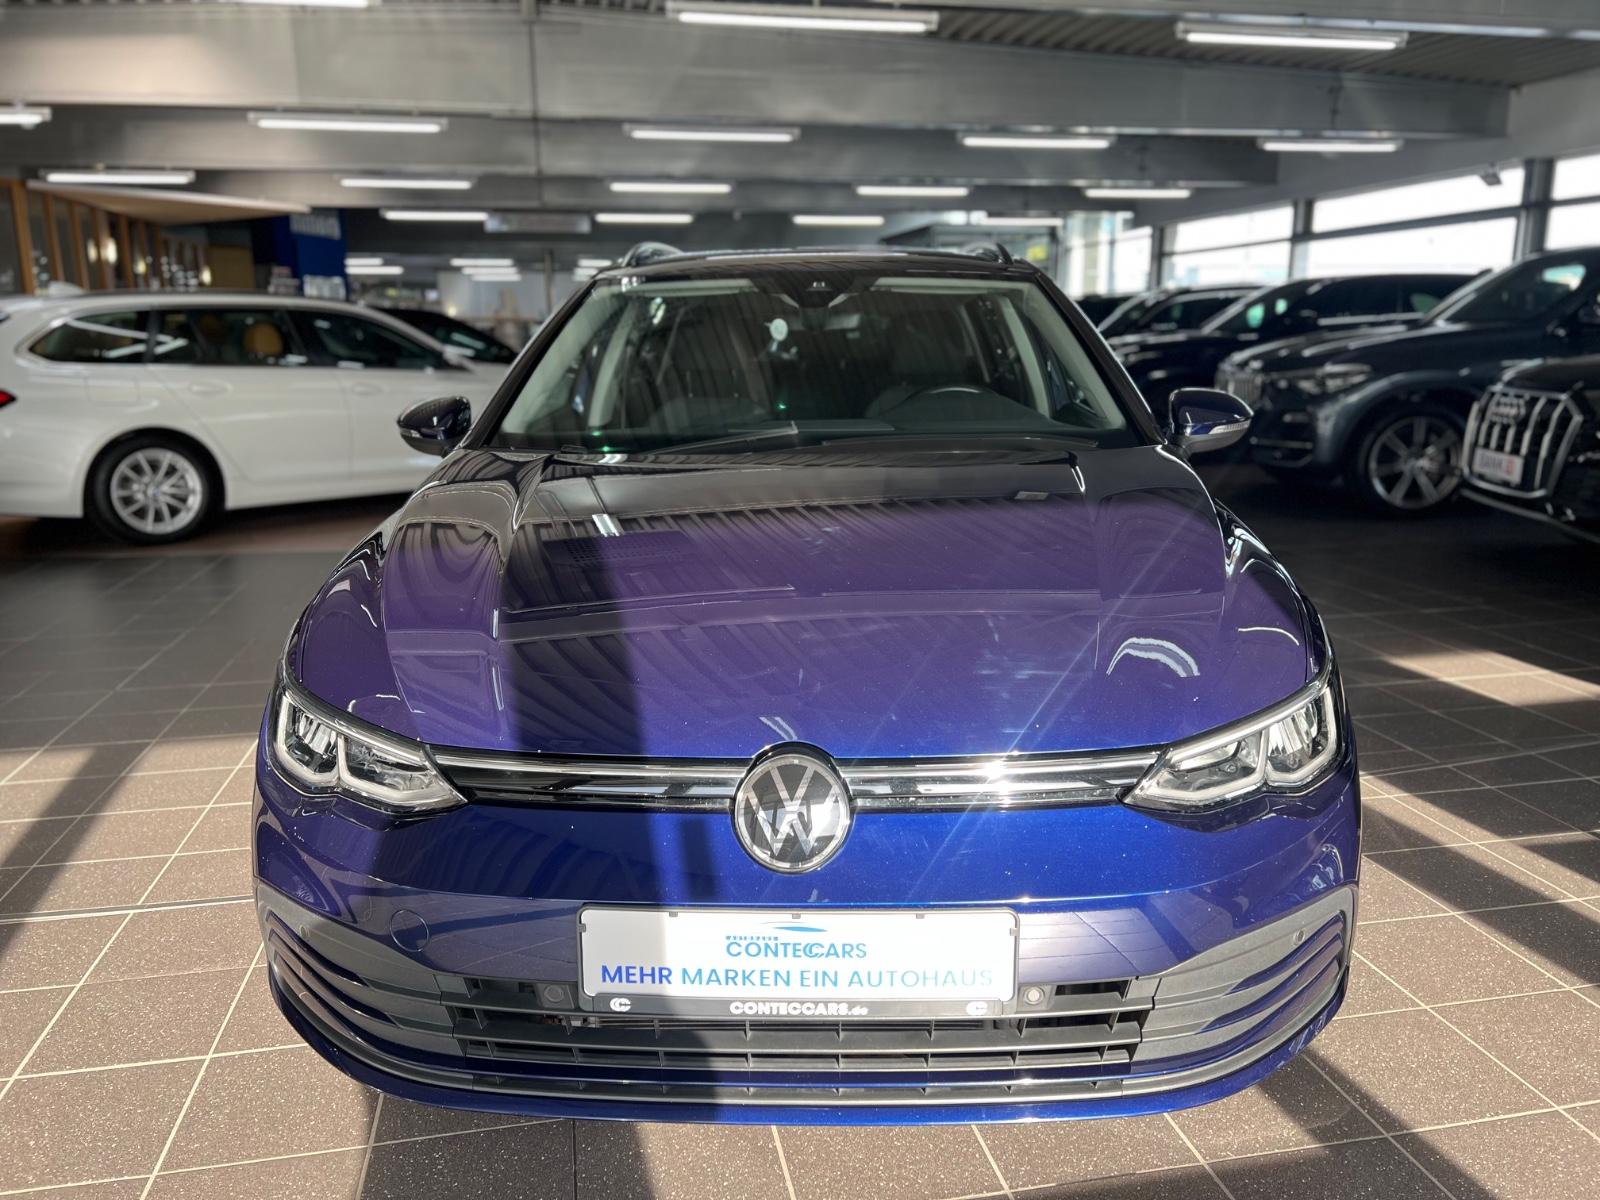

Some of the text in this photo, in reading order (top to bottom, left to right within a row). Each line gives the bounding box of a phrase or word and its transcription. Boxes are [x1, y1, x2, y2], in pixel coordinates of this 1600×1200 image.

[600, 965, 993, 988] MEHR MARKEN EIN AUTOHAUS
[729, 1001, 869, 1016] CONTECCARS.de
